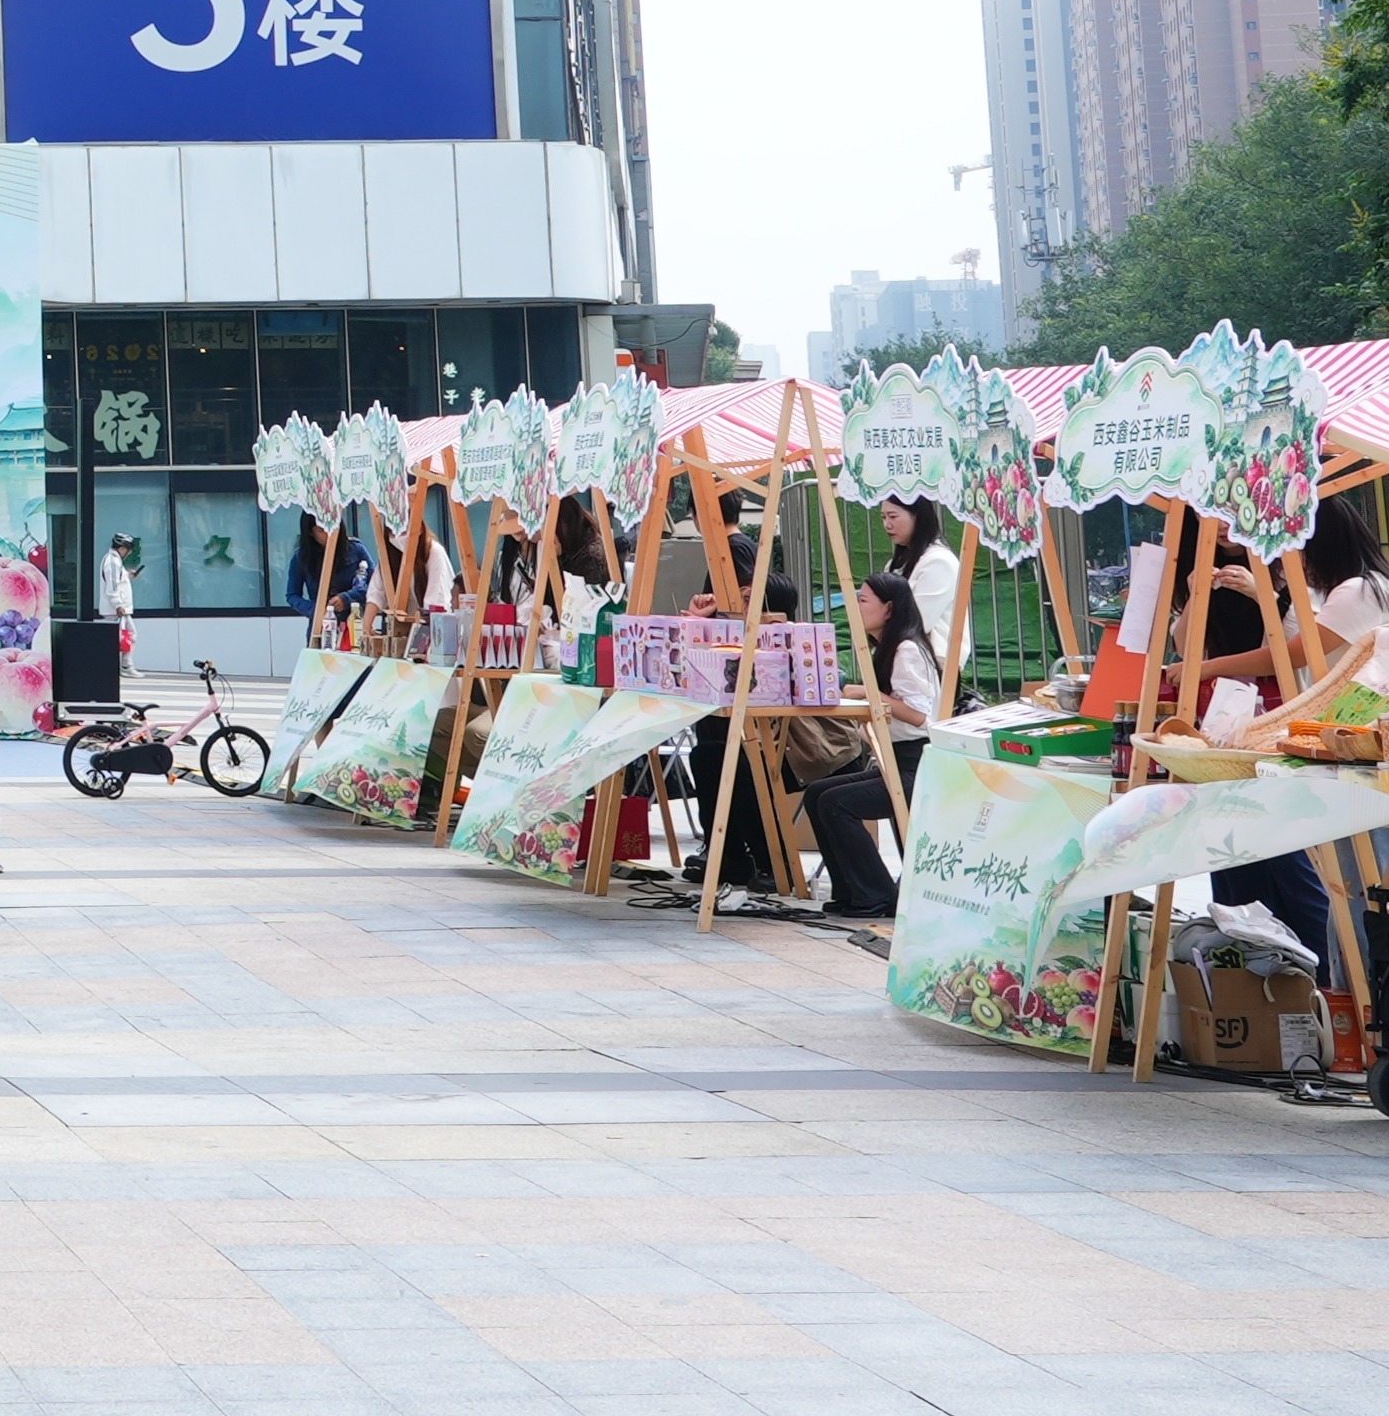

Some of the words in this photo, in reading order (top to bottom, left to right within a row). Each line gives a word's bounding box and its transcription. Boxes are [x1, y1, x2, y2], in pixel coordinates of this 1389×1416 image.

[863, 426, 944, 449] 陕西秦农汇农业发展
[1093, 413, 1190, 446] 西安鑫谷玉米制品
[886, 454, 922, 476] 有限公司
[1113, 446, 1162, 474] 有限公司
